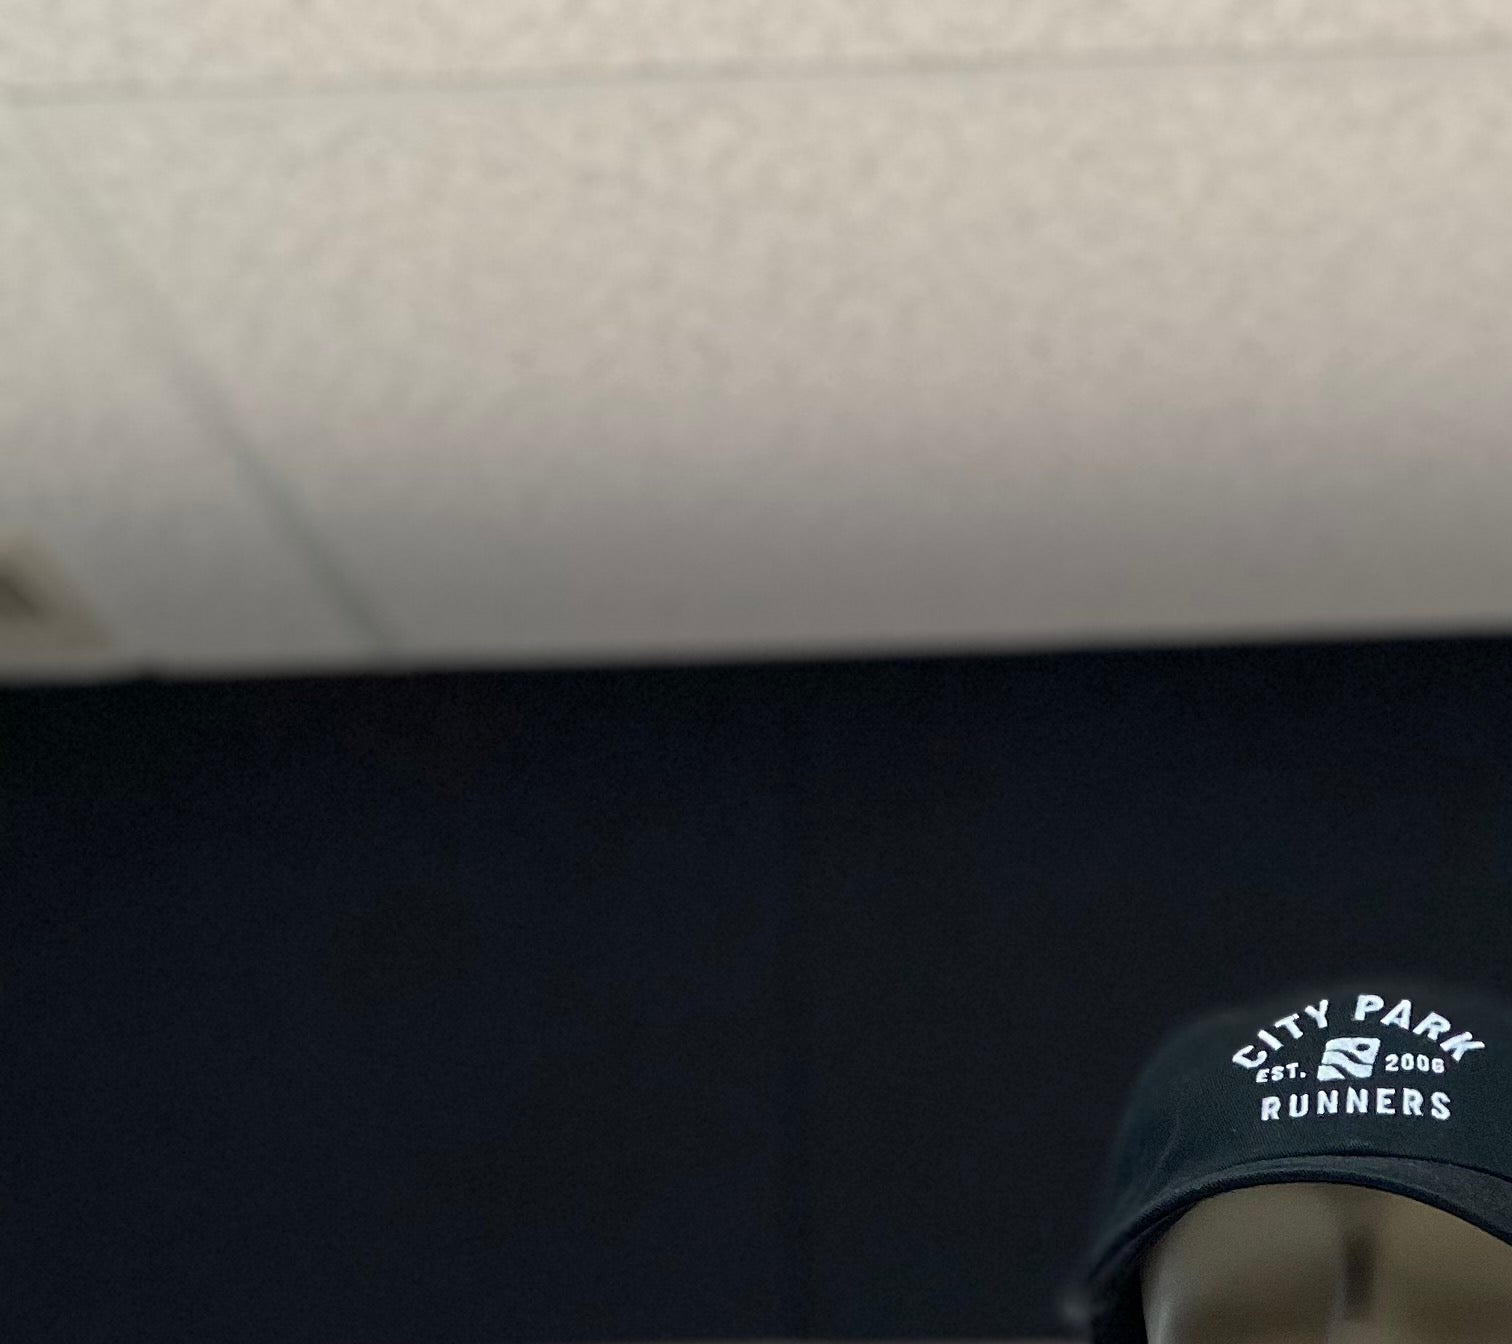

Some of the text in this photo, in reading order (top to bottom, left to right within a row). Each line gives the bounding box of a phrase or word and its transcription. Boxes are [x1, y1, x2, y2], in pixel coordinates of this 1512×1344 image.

[1231, 994, 1486, 1069] CITY PARK
[1255, 1052, 1446, 1083] EST. 2006
[1260, 1086, 1452, 1121] RUNNERS
